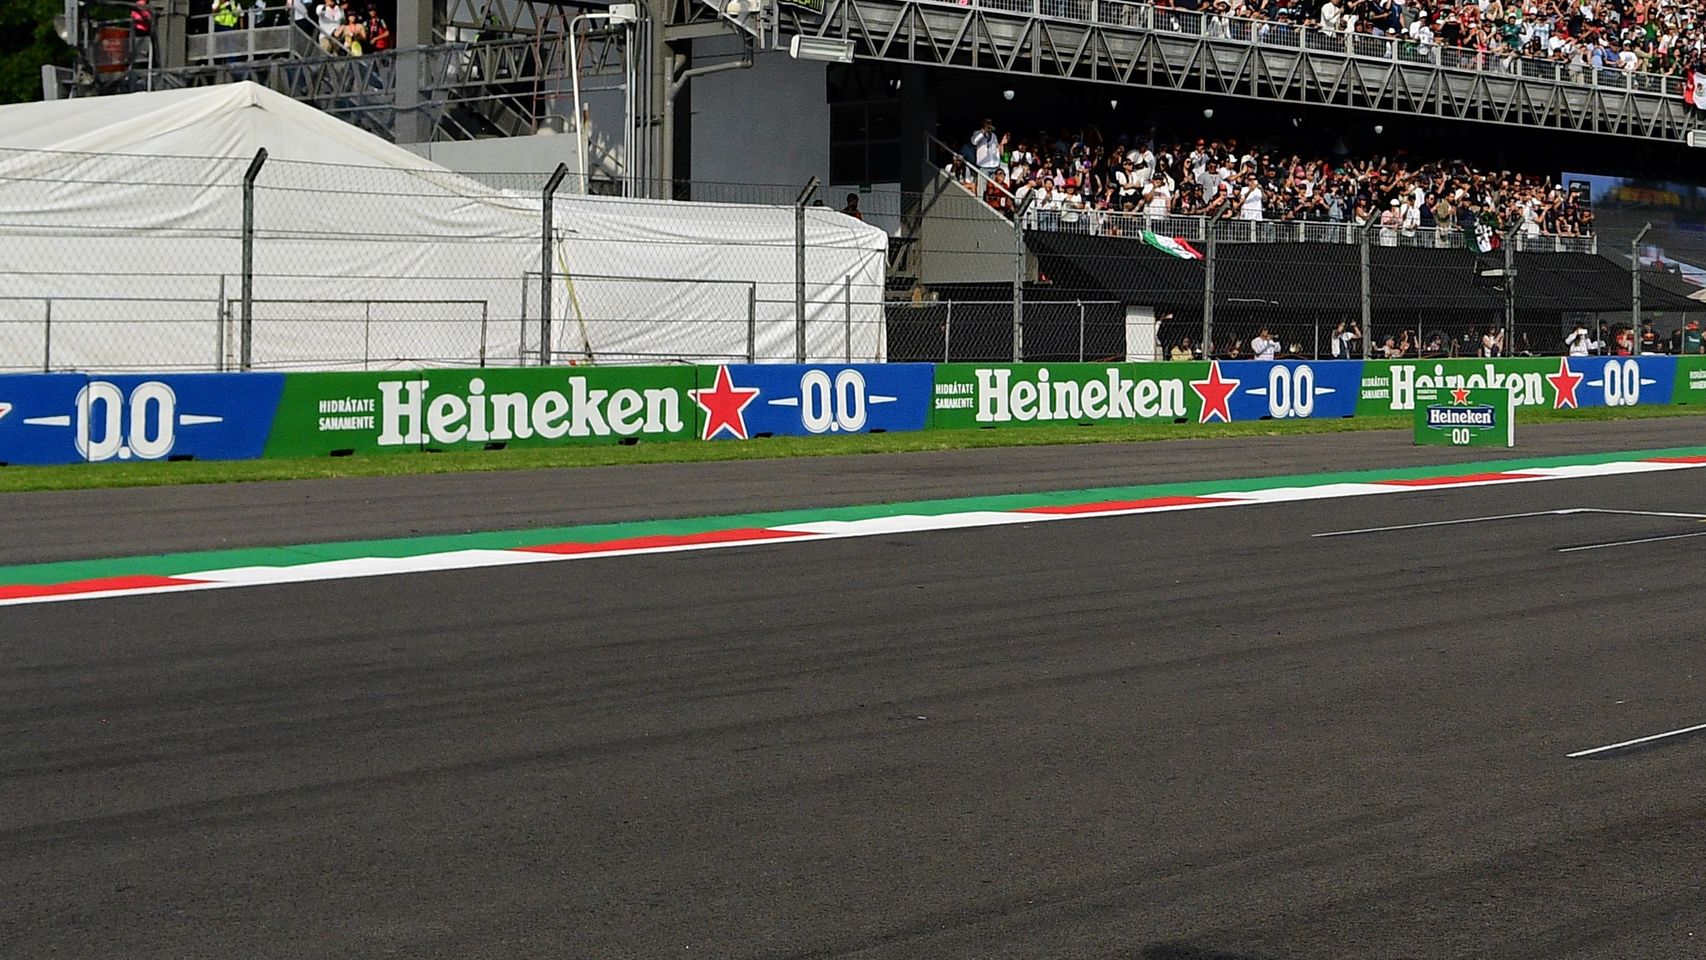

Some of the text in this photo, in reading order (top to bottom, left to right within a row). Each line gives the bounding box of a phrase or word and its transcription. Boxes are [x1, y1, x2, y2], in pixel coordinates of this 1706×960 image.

[319, 396, 375, 414] HIDRÁTATE
[800, 369, 867, 433] 0.0
[935, 381, 974, 395] HIDRÁTATE
[935, 397, 974, 409] SANAMENTE
[975, 368, 1187, 422] Heineken
[1268, 365, 1314, 418] 0.0
[1603, 360, 1640, 406] 0.0
[75, 381, 176, 460] 0.0
[319, 415, 375, 431] SANAMENTE
[377, 376, 683, 446] Heineken
[1430, 409, 1492, 423] Heineken
